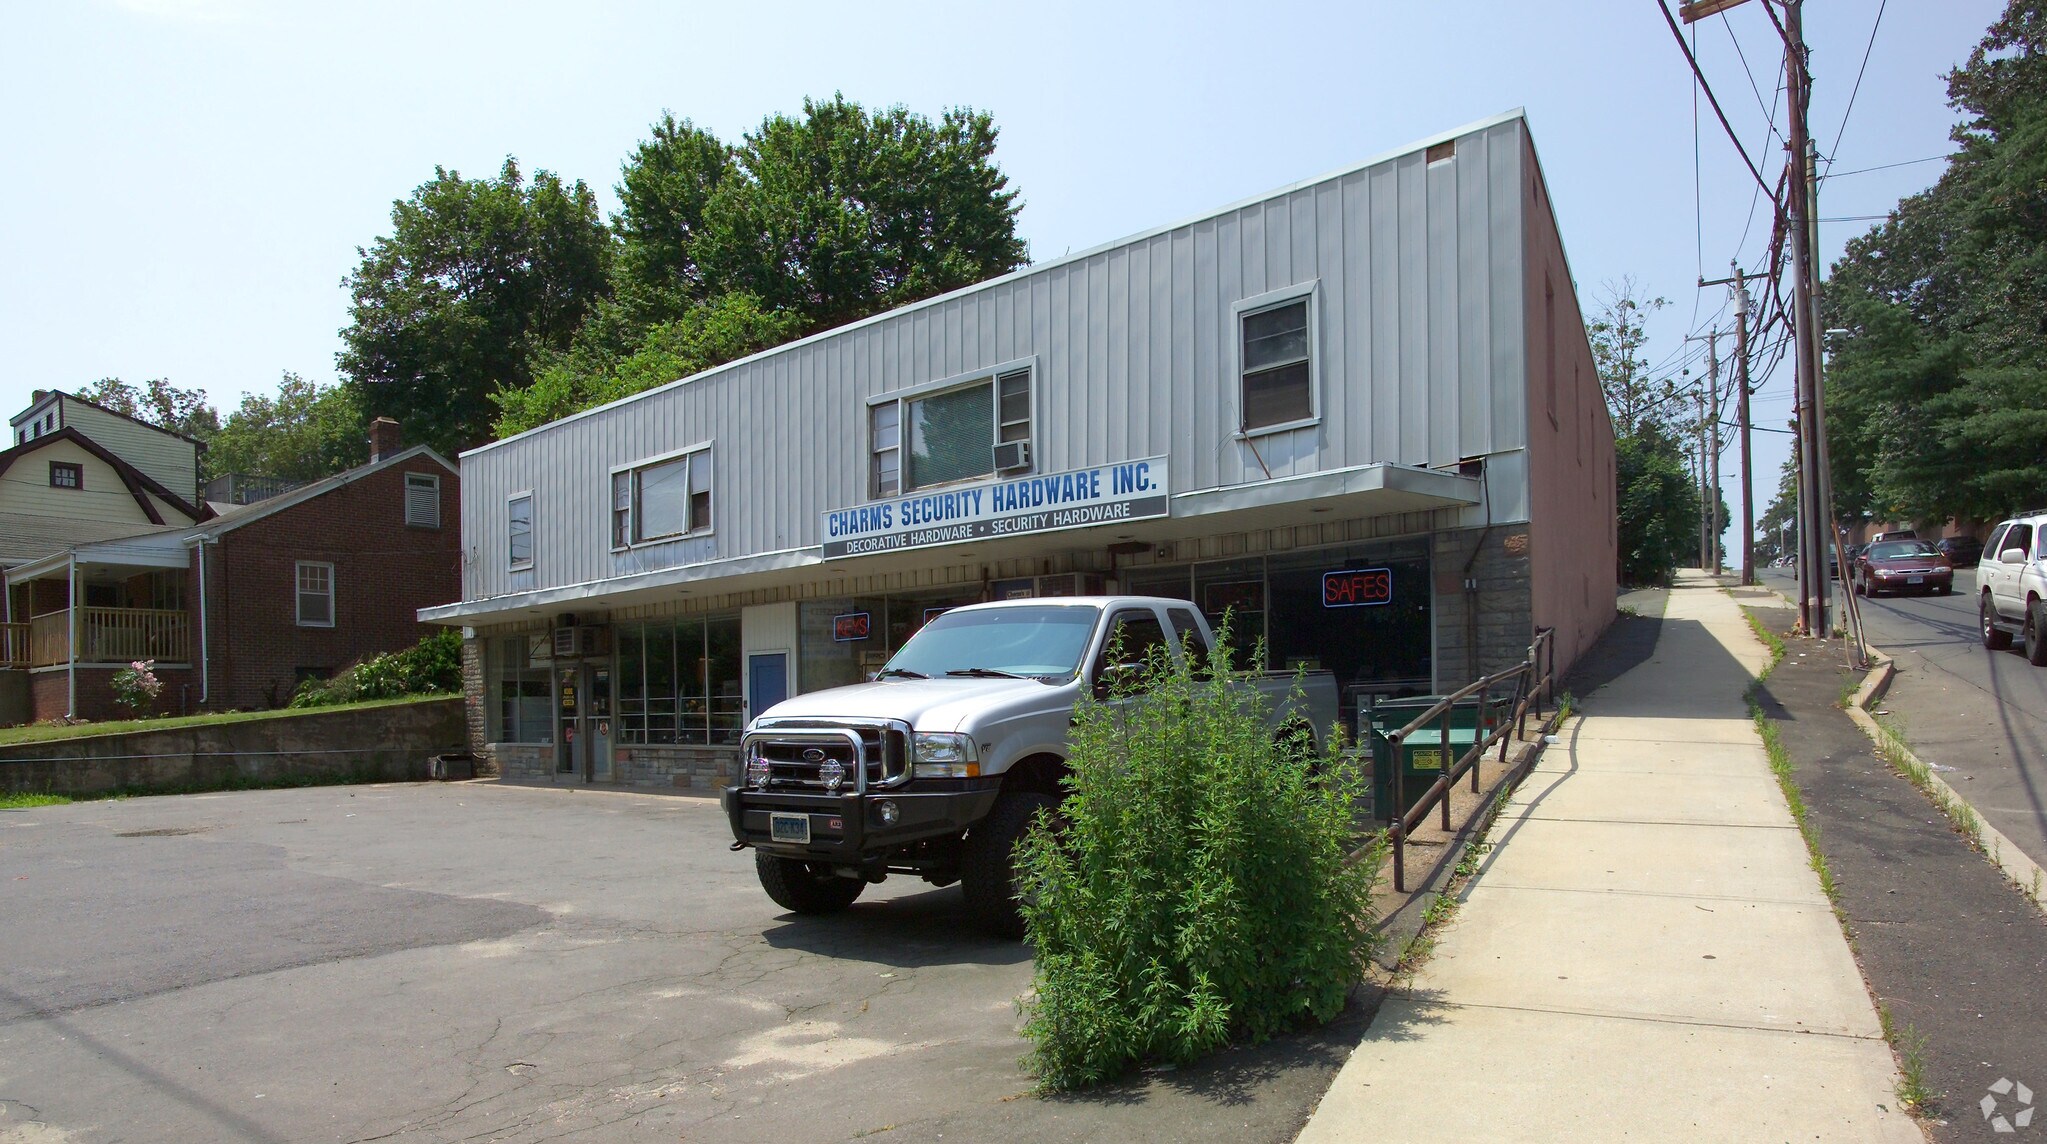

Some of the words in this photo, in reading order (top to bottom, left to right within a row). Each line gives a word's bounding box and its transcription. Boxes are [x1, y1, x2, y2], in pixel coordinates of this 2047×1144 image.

[900, 489, 983, 524] SECURITY
[992, 473, 1100, 512] HARDWARE
[1112, 462, 1157, 495] INC.
[846, 534, 907, 554] DECORATIVE
[910, 525, 973, 545] HARDWARE
[991, 514, 1048, 534] SECURITY
[1053, 502, 1130, 525] HARDWARE
[1325, 575, 1389, 602] SAFES
[837, 617, 868, 636] KEYS
